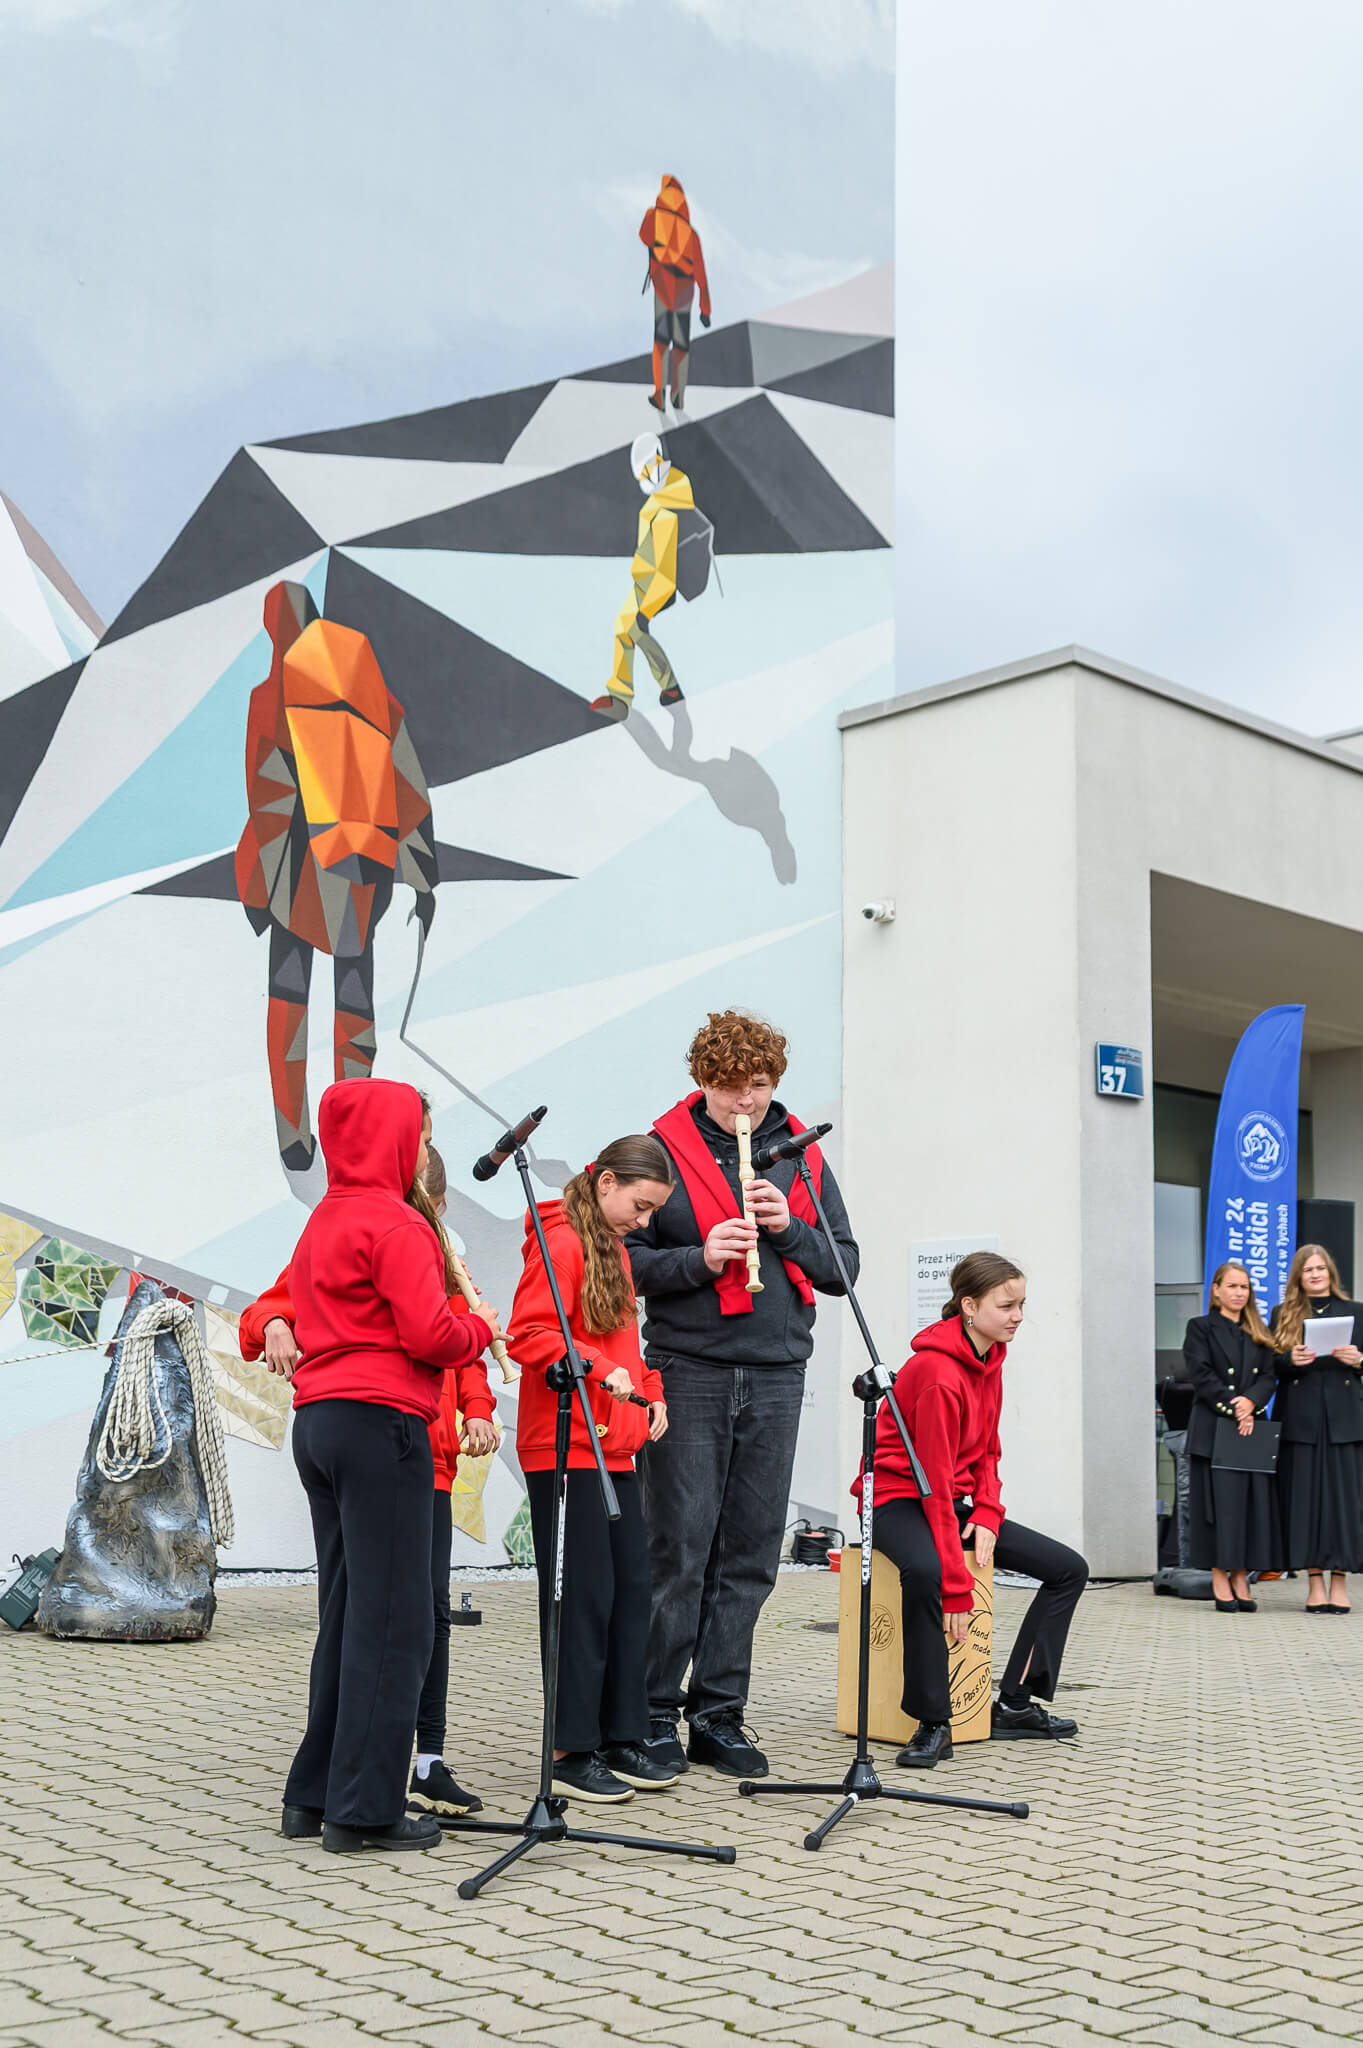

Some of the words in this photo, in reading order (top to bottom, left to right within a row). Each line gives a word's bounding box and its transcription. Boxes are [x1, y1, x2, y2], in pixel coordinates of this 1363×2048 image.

[1101, 1065, 1126, 1093] 37
[1225, 1197, 1245, 1223] 24
[1275, 1204, 1290, 1247] Tychach
[1228, 1227, 1244, 1251] nr
[1245, 1201, 1268, 1292] Polskich
[918, 1255, 943, 1264] Przez
[1278, 1248, 1288, 1259] w
[918, 1268, 930, 1279] do
[932, 1266, 951, 1280] gwi
[969, 1625, 990, 1640] Hand
[972, 1643, 991, 1656] made
[951, 1695, 962, 1709] th
